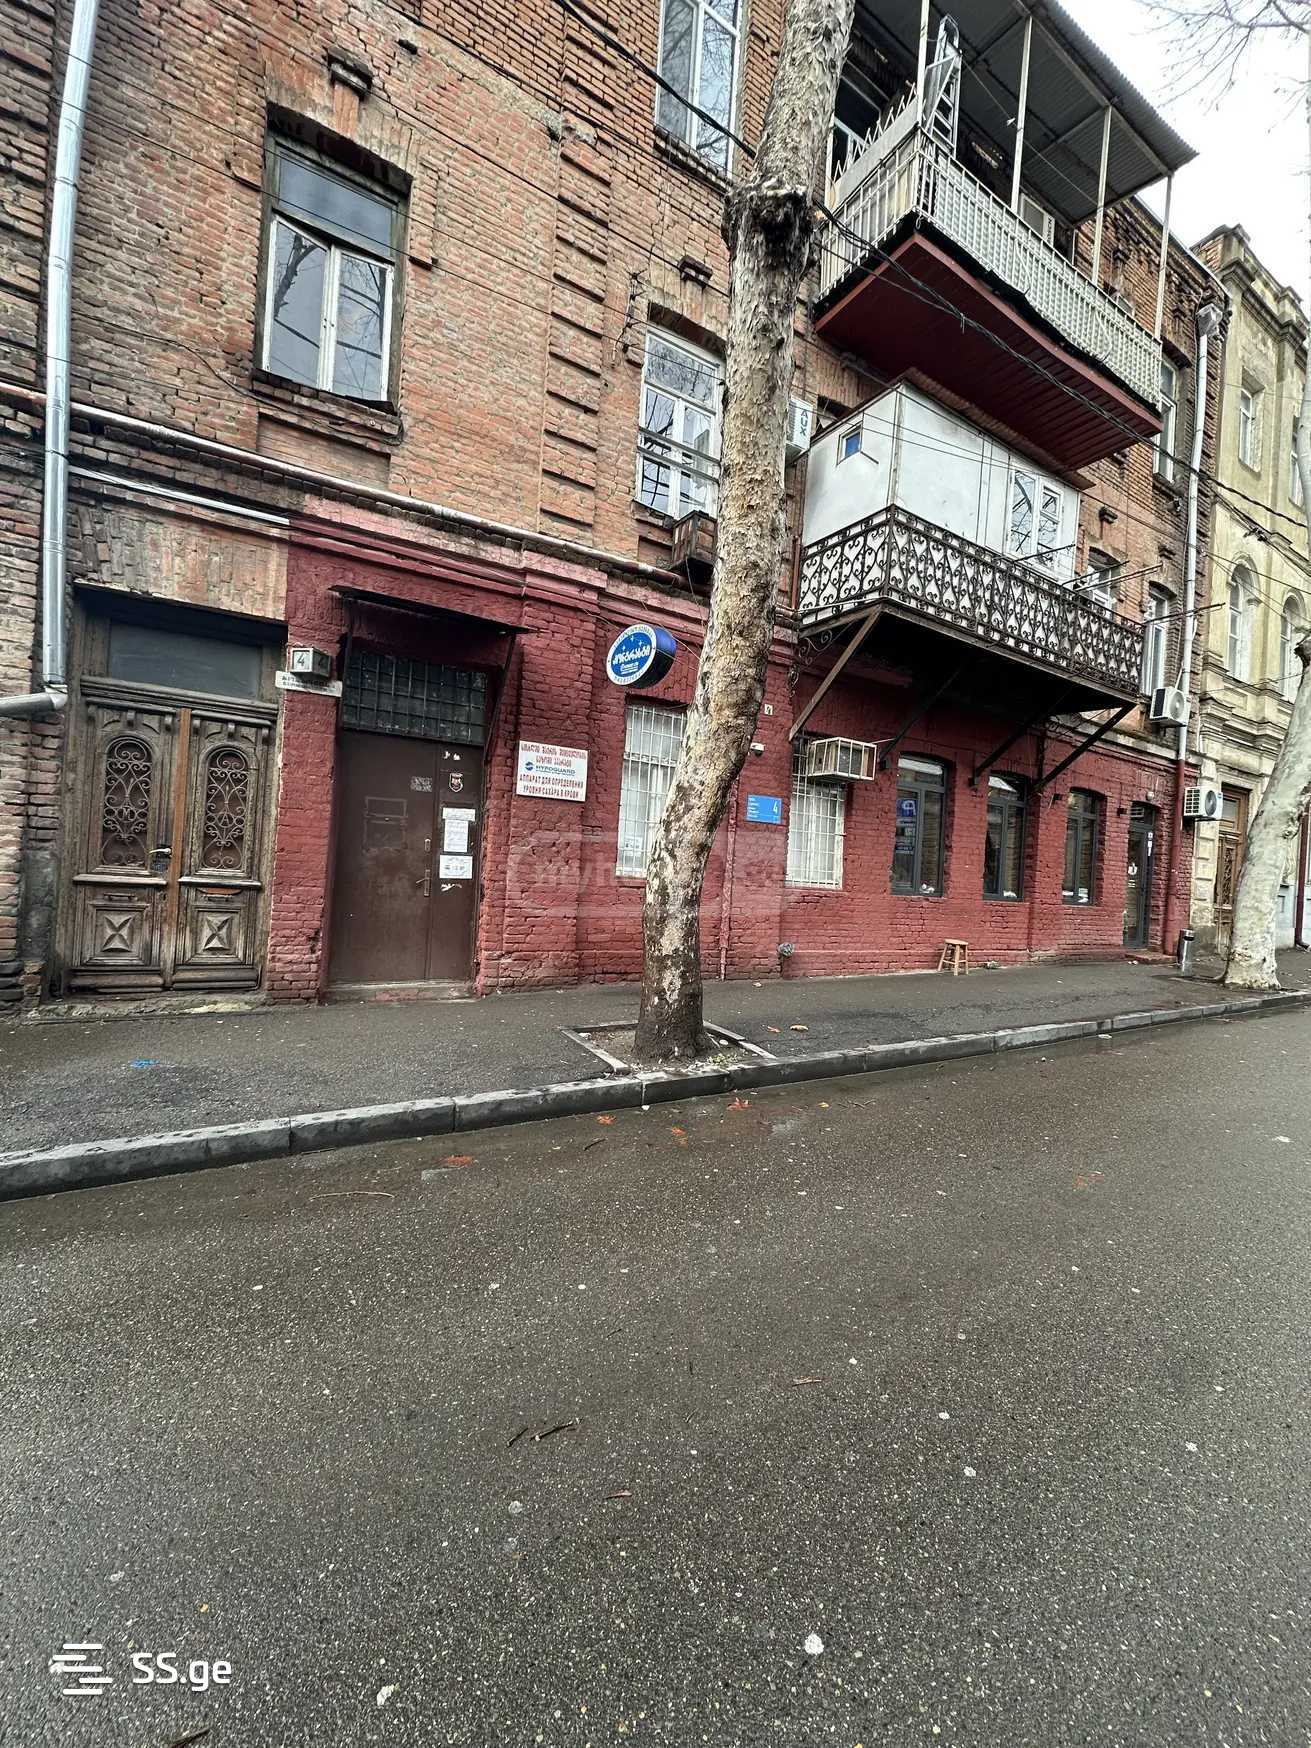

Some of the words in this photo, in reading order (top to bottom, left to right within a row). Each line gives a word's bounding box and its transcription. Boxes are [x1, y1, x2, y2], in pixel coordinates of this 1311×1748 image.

[800, 410, 808, 436] AUX
[297, 652, 305, 667] 4
[519, 774, 541, 783] АППАРАТ
[523, 785, 542, 795] УРОВНЯ
[542, 786, 560, 796] САХАРА
[564, 789, 579, 798] КРОВИ
[773, 800, 779, 815] 4
